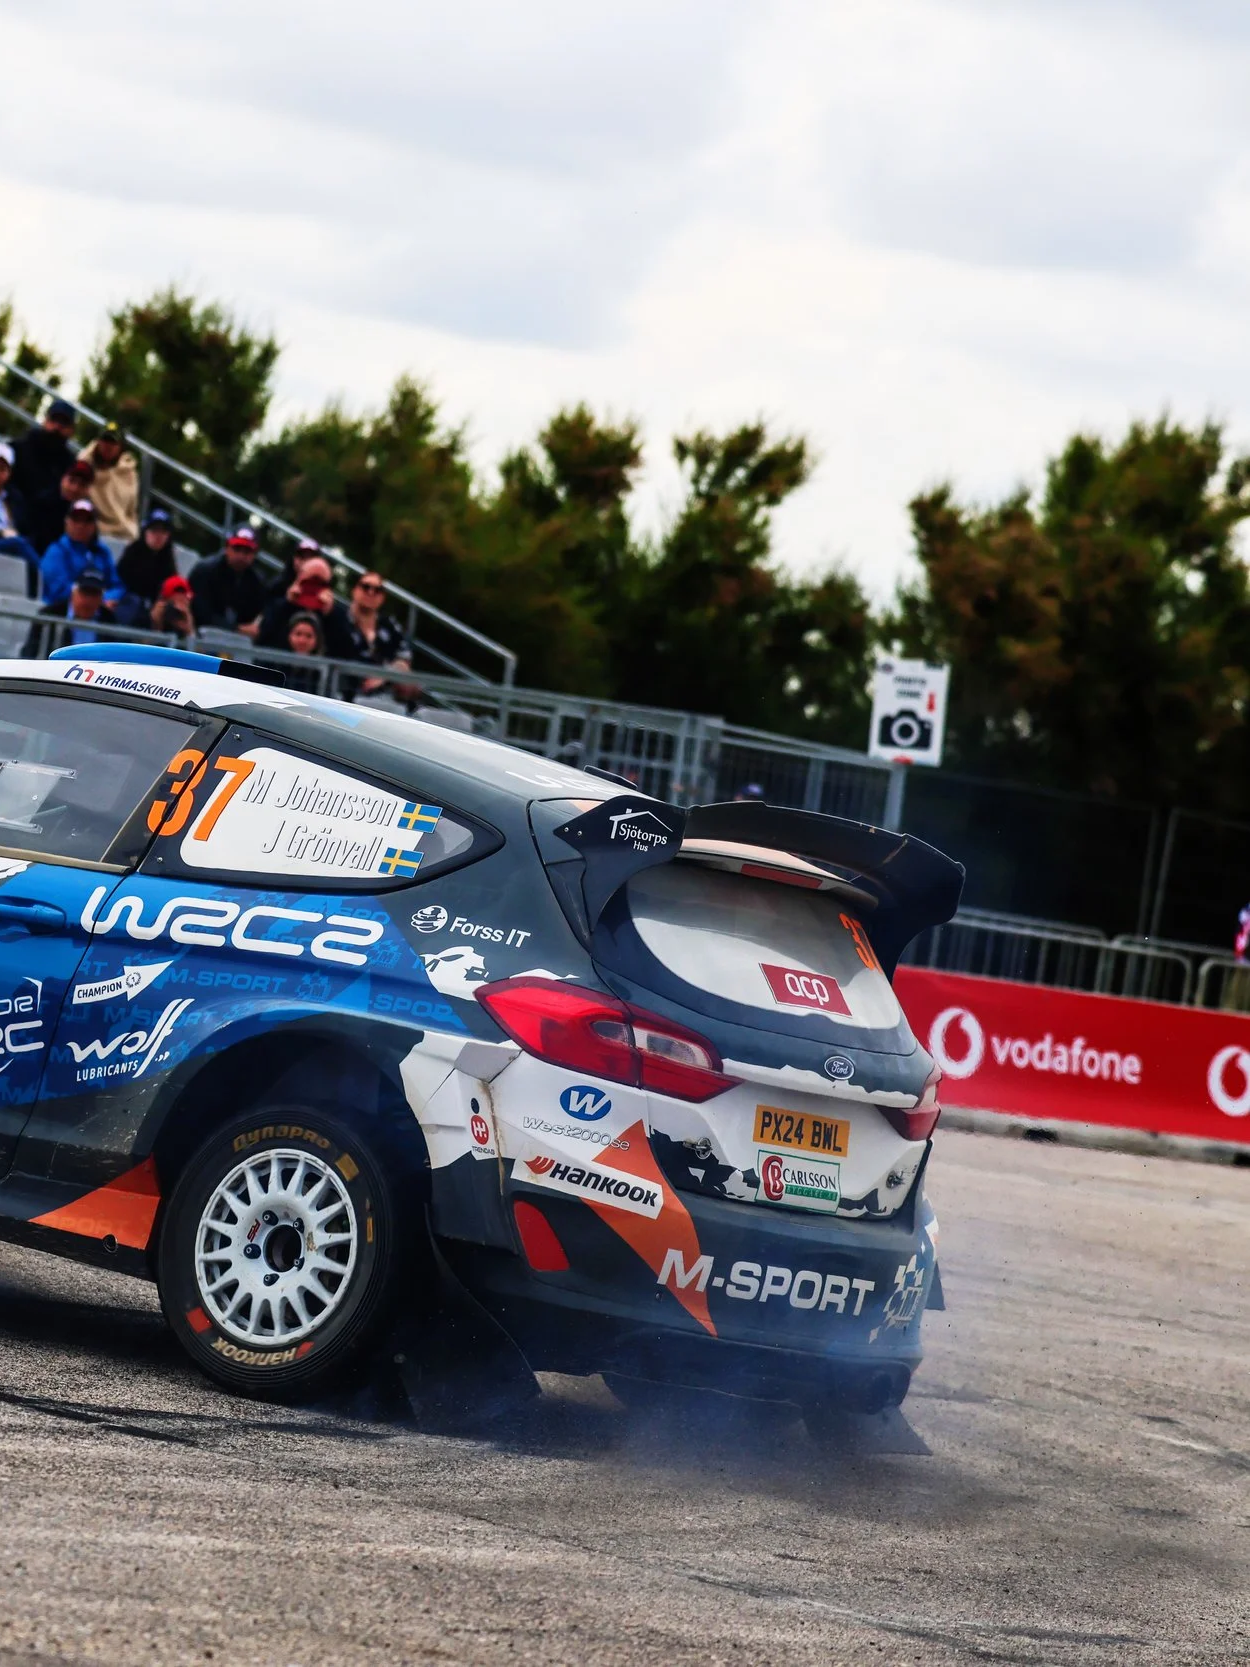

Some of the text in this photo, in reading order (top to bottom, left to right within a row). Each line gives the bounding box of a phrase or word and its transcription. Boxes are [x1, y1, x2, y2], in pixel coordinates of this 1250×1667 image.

[95, 674, 181, 700] HYRMASKINER
[146, 748, 256, 842] 37
[242, 769, 398, 827] M Johansson
[260, 819, 383, 872] J Grönvall
[618, 823, 668, 847] Sjötorps
[633, 840, 649, 852] Hus
[80, 886, 384, 965] WRC2
[449, 916, 531, 948] Forss IT
[77, 981, 122, 999] CHAMPION
[784, 973, 830, 1005] acp
[66, 998, 196, 1079] wolf
[76, 1060, 138, 1082] LUBRICANTS
[831, 1060, 849, 1075] Ford
[992, 1035, 1142, 1084] vodafone
[760, 1111, 805, 1145] PX24
[783, 1168, 837, 1190] CARLSSON
[657, 1248, 875, 1317] M-SPORT
